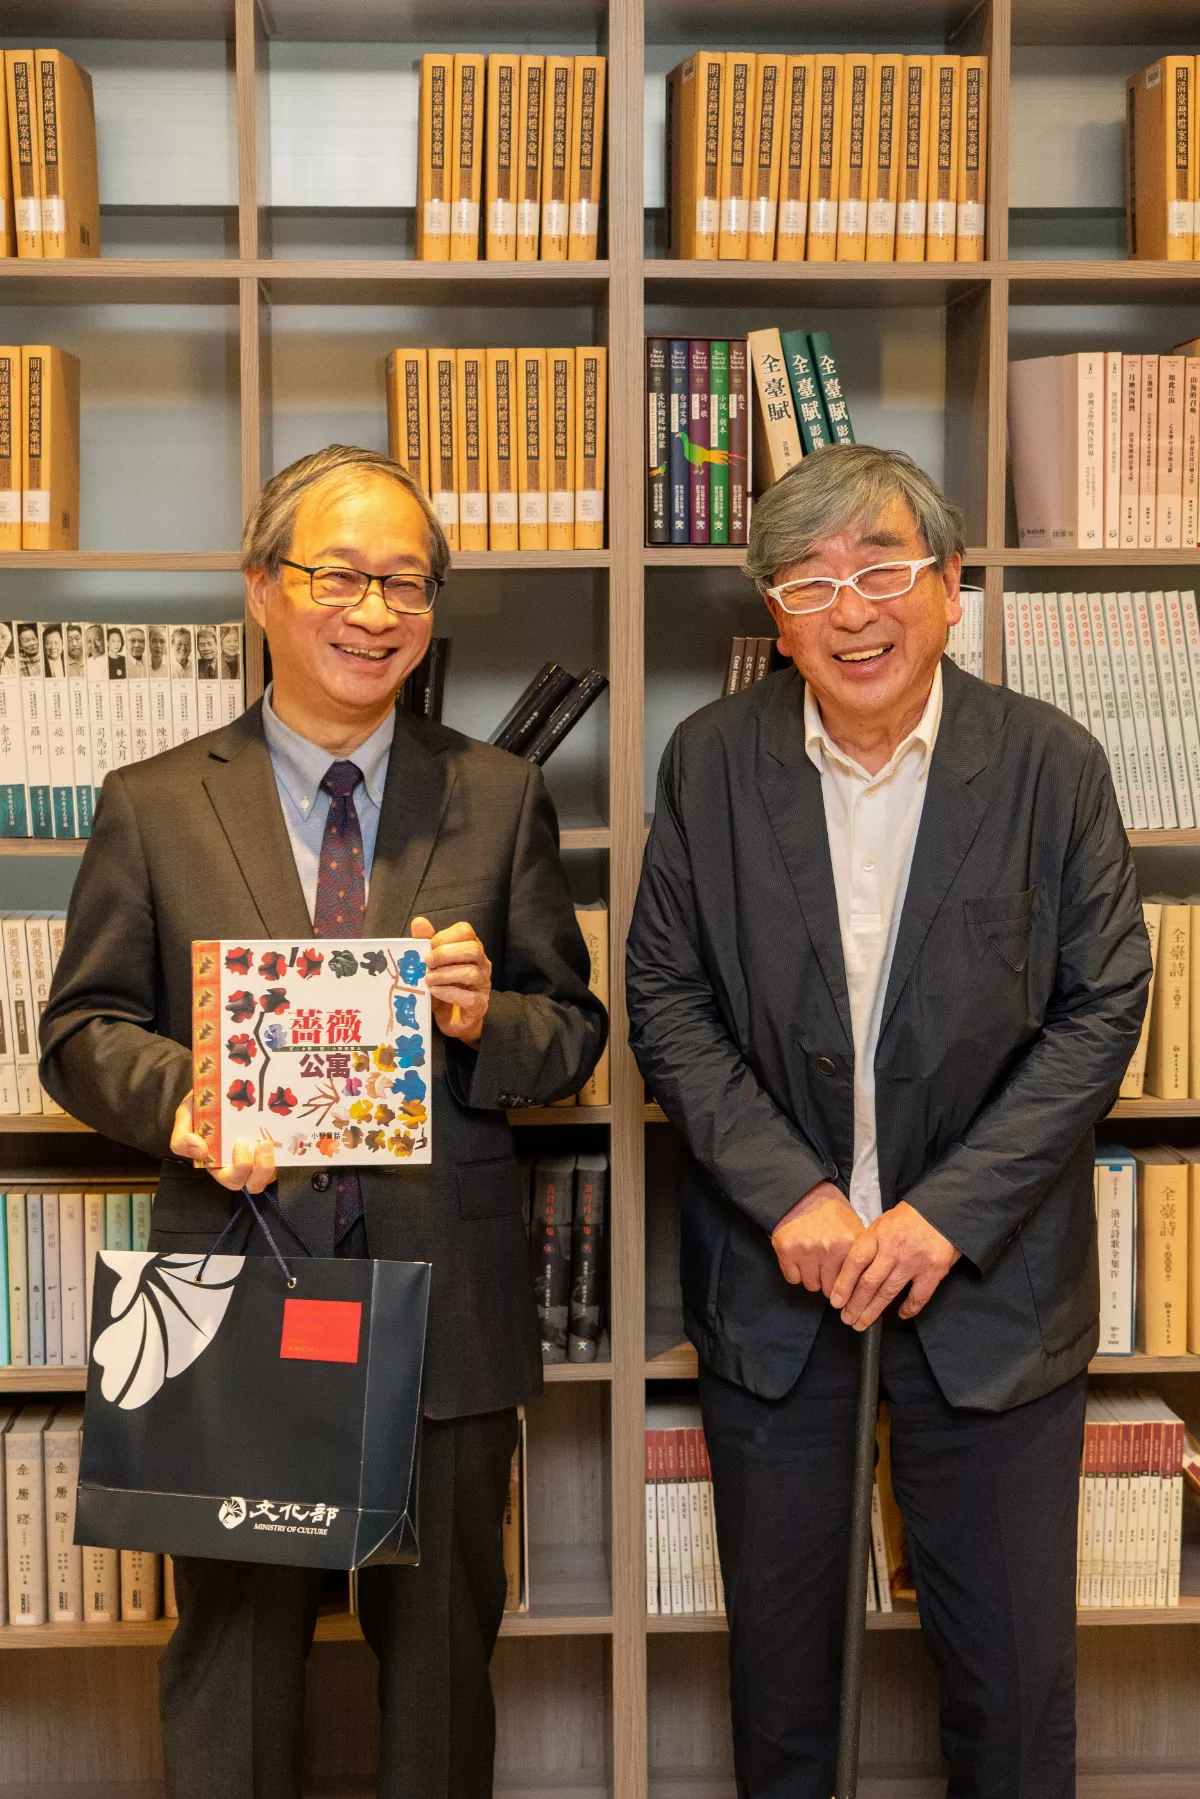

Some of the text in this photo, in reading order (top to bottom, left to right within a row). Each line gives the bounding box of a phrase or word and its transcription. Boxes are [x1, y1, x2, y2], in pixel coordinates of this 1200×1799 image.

[760, 354, 792, 422] 全臺賦
[1, 724, 12, 756] 余光中
[30, 725, 42, 756] 羅門
[74, 725, 87, 756] 商禽
[96, 727, 108, 770] 司馬中原
[115, 727, 127, 761] 林文月
[135, 727, 147, 760] 鄭愁予
[7, 927, 23, 980] 張秀亞全集
[30, 927, 46, 980] 張秀亞全集
[1169, 927, 1186, 978] 全臺詩
[15, 983, 23, 997] 5
[37, 983, 47, 997] 6
[288, 1009, 362, 1045] 薔薇
[298, 1053, 351, 1079] 公寓
[1159, 1186, 1177, 1237] 全臺詩
[249, 1499, 340, 1527] 文化部
[253, 1523, 287, 1533] MINISTRY
[296, 1526, 329, 1536] CULTURE
